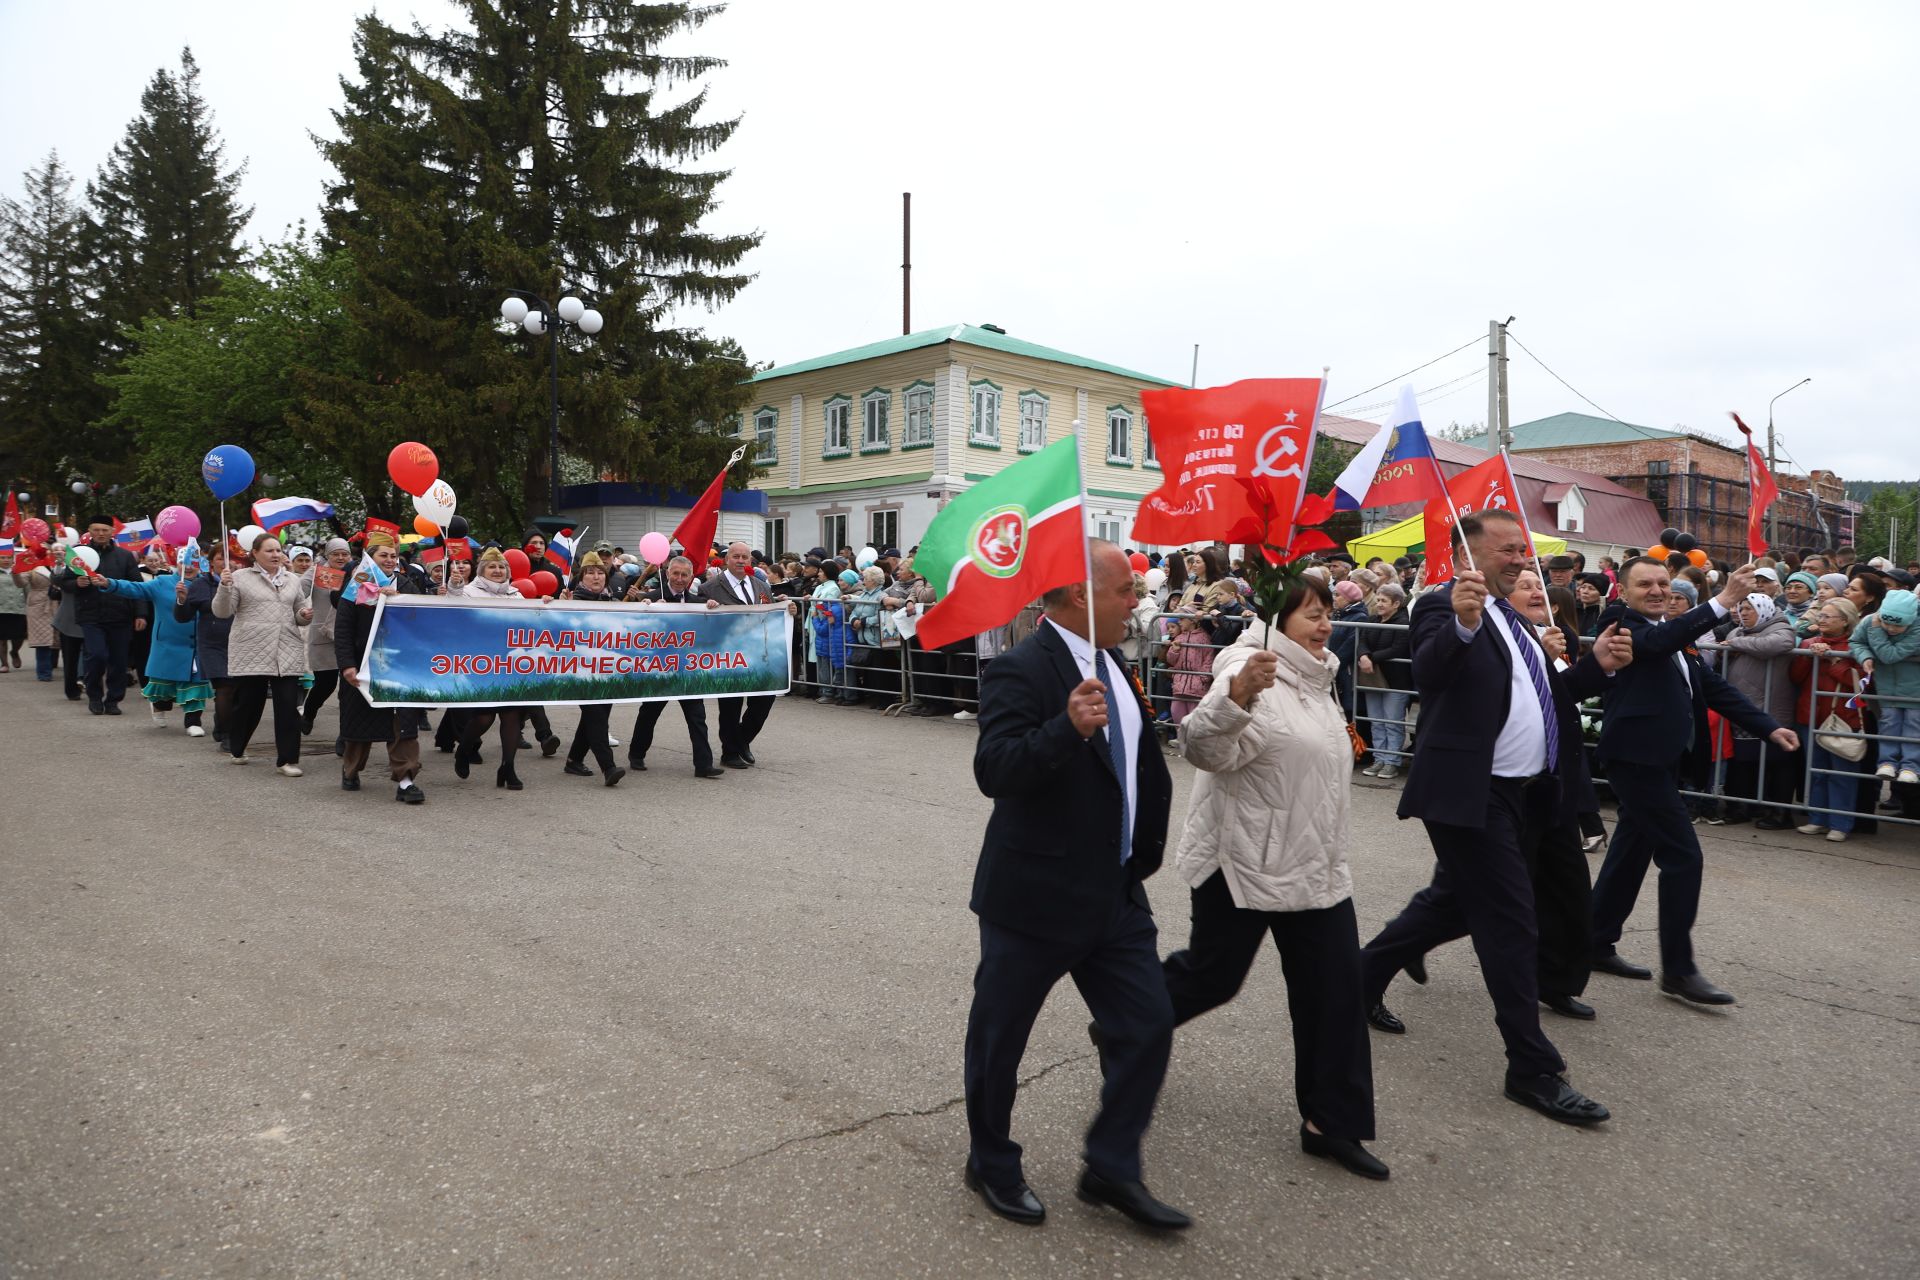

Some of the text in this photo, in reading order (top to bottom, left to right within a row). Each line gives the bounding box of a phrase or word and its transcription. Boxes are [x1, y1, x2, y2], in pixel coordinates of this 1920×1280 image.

[507, 628, 696, 652] ШАДЧИНСКАЯ
[431, 651, 748, 675] ЭКОНОМИЧЕСКАЯ ЗОНА
